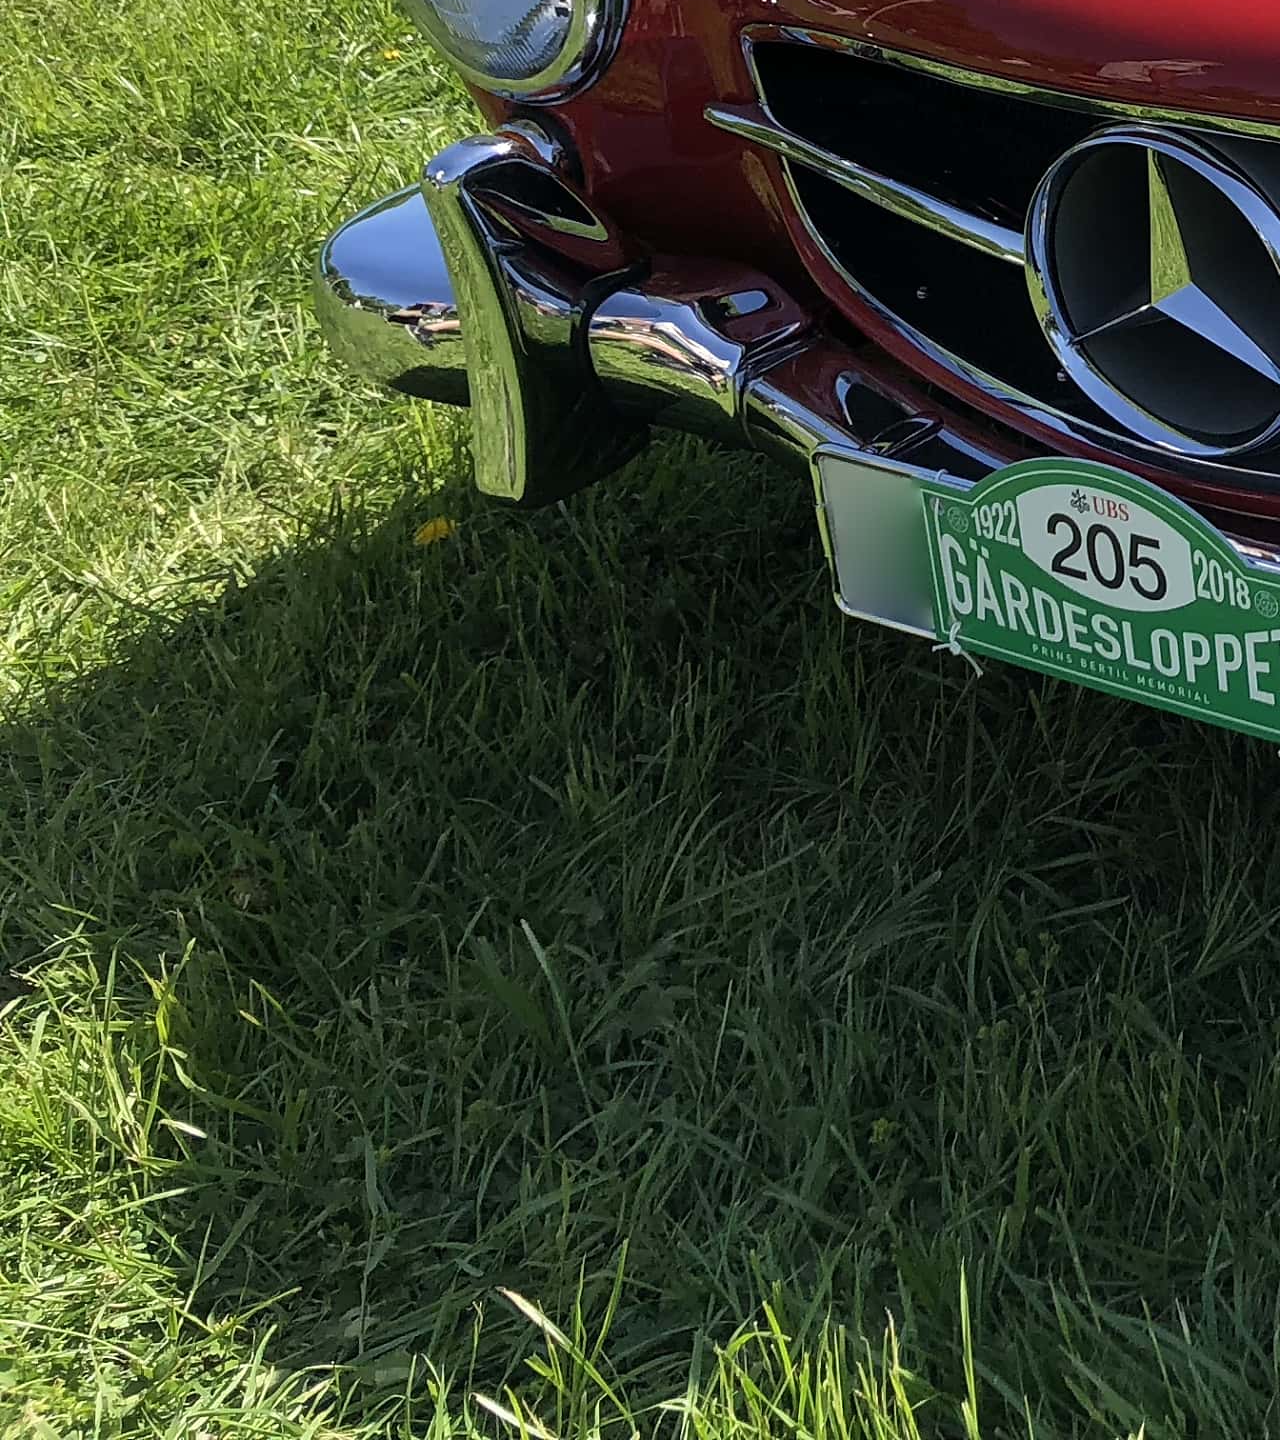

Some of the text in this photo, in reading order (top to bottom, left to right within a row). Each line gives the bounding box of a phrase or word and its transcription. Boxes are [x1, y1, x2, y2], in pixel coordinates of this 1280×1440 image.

[970, 500, 1020, 547] 1922
[1093, 495, 1130, 521] UBS
[1047, 512, 1168, 601] 205
[1193, 549, 1251, 610] 2018
[1032, 643, 1212, 706] PRINS BERTIL MEMORIAL
